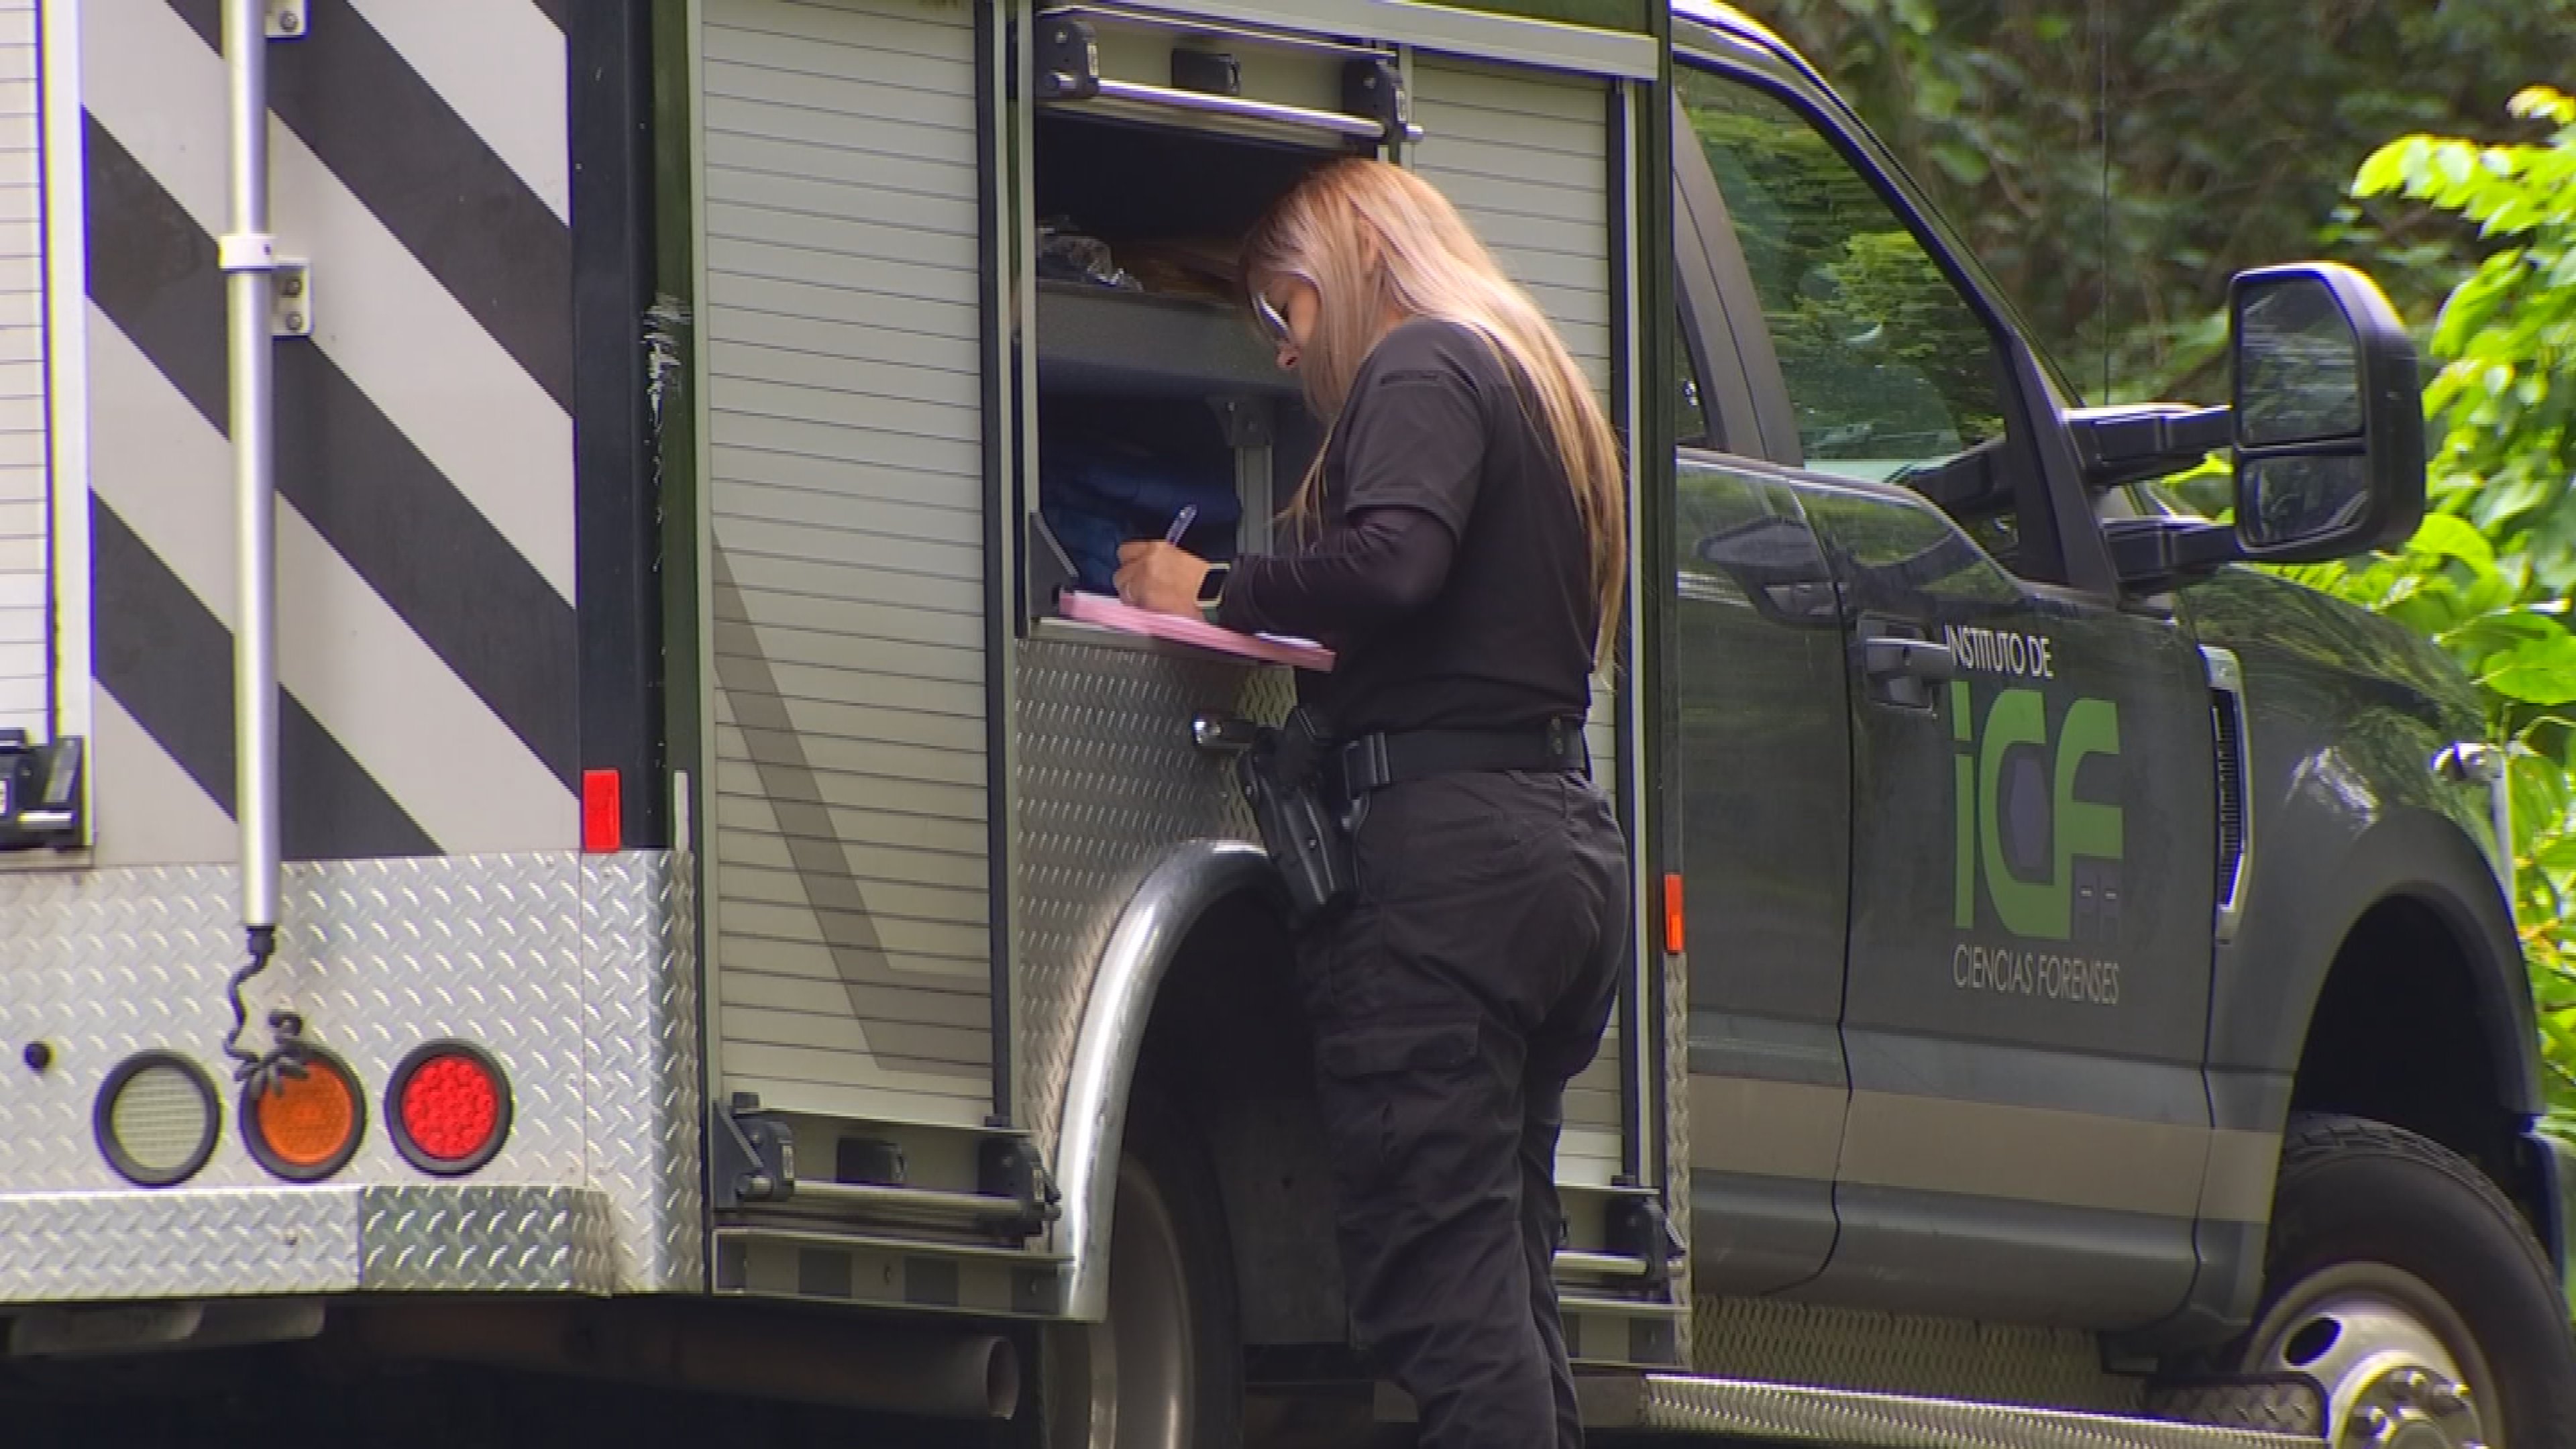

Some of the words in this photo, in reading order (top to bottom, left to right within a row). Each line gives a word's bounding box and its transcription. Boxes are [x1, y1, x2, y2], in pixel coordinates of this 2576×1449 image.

[2027, 635, 2054, 678] DE
[1953, 943, 2033, 994] CIENCIAS
[2037, 954, 2120, 1004] FORENSES
